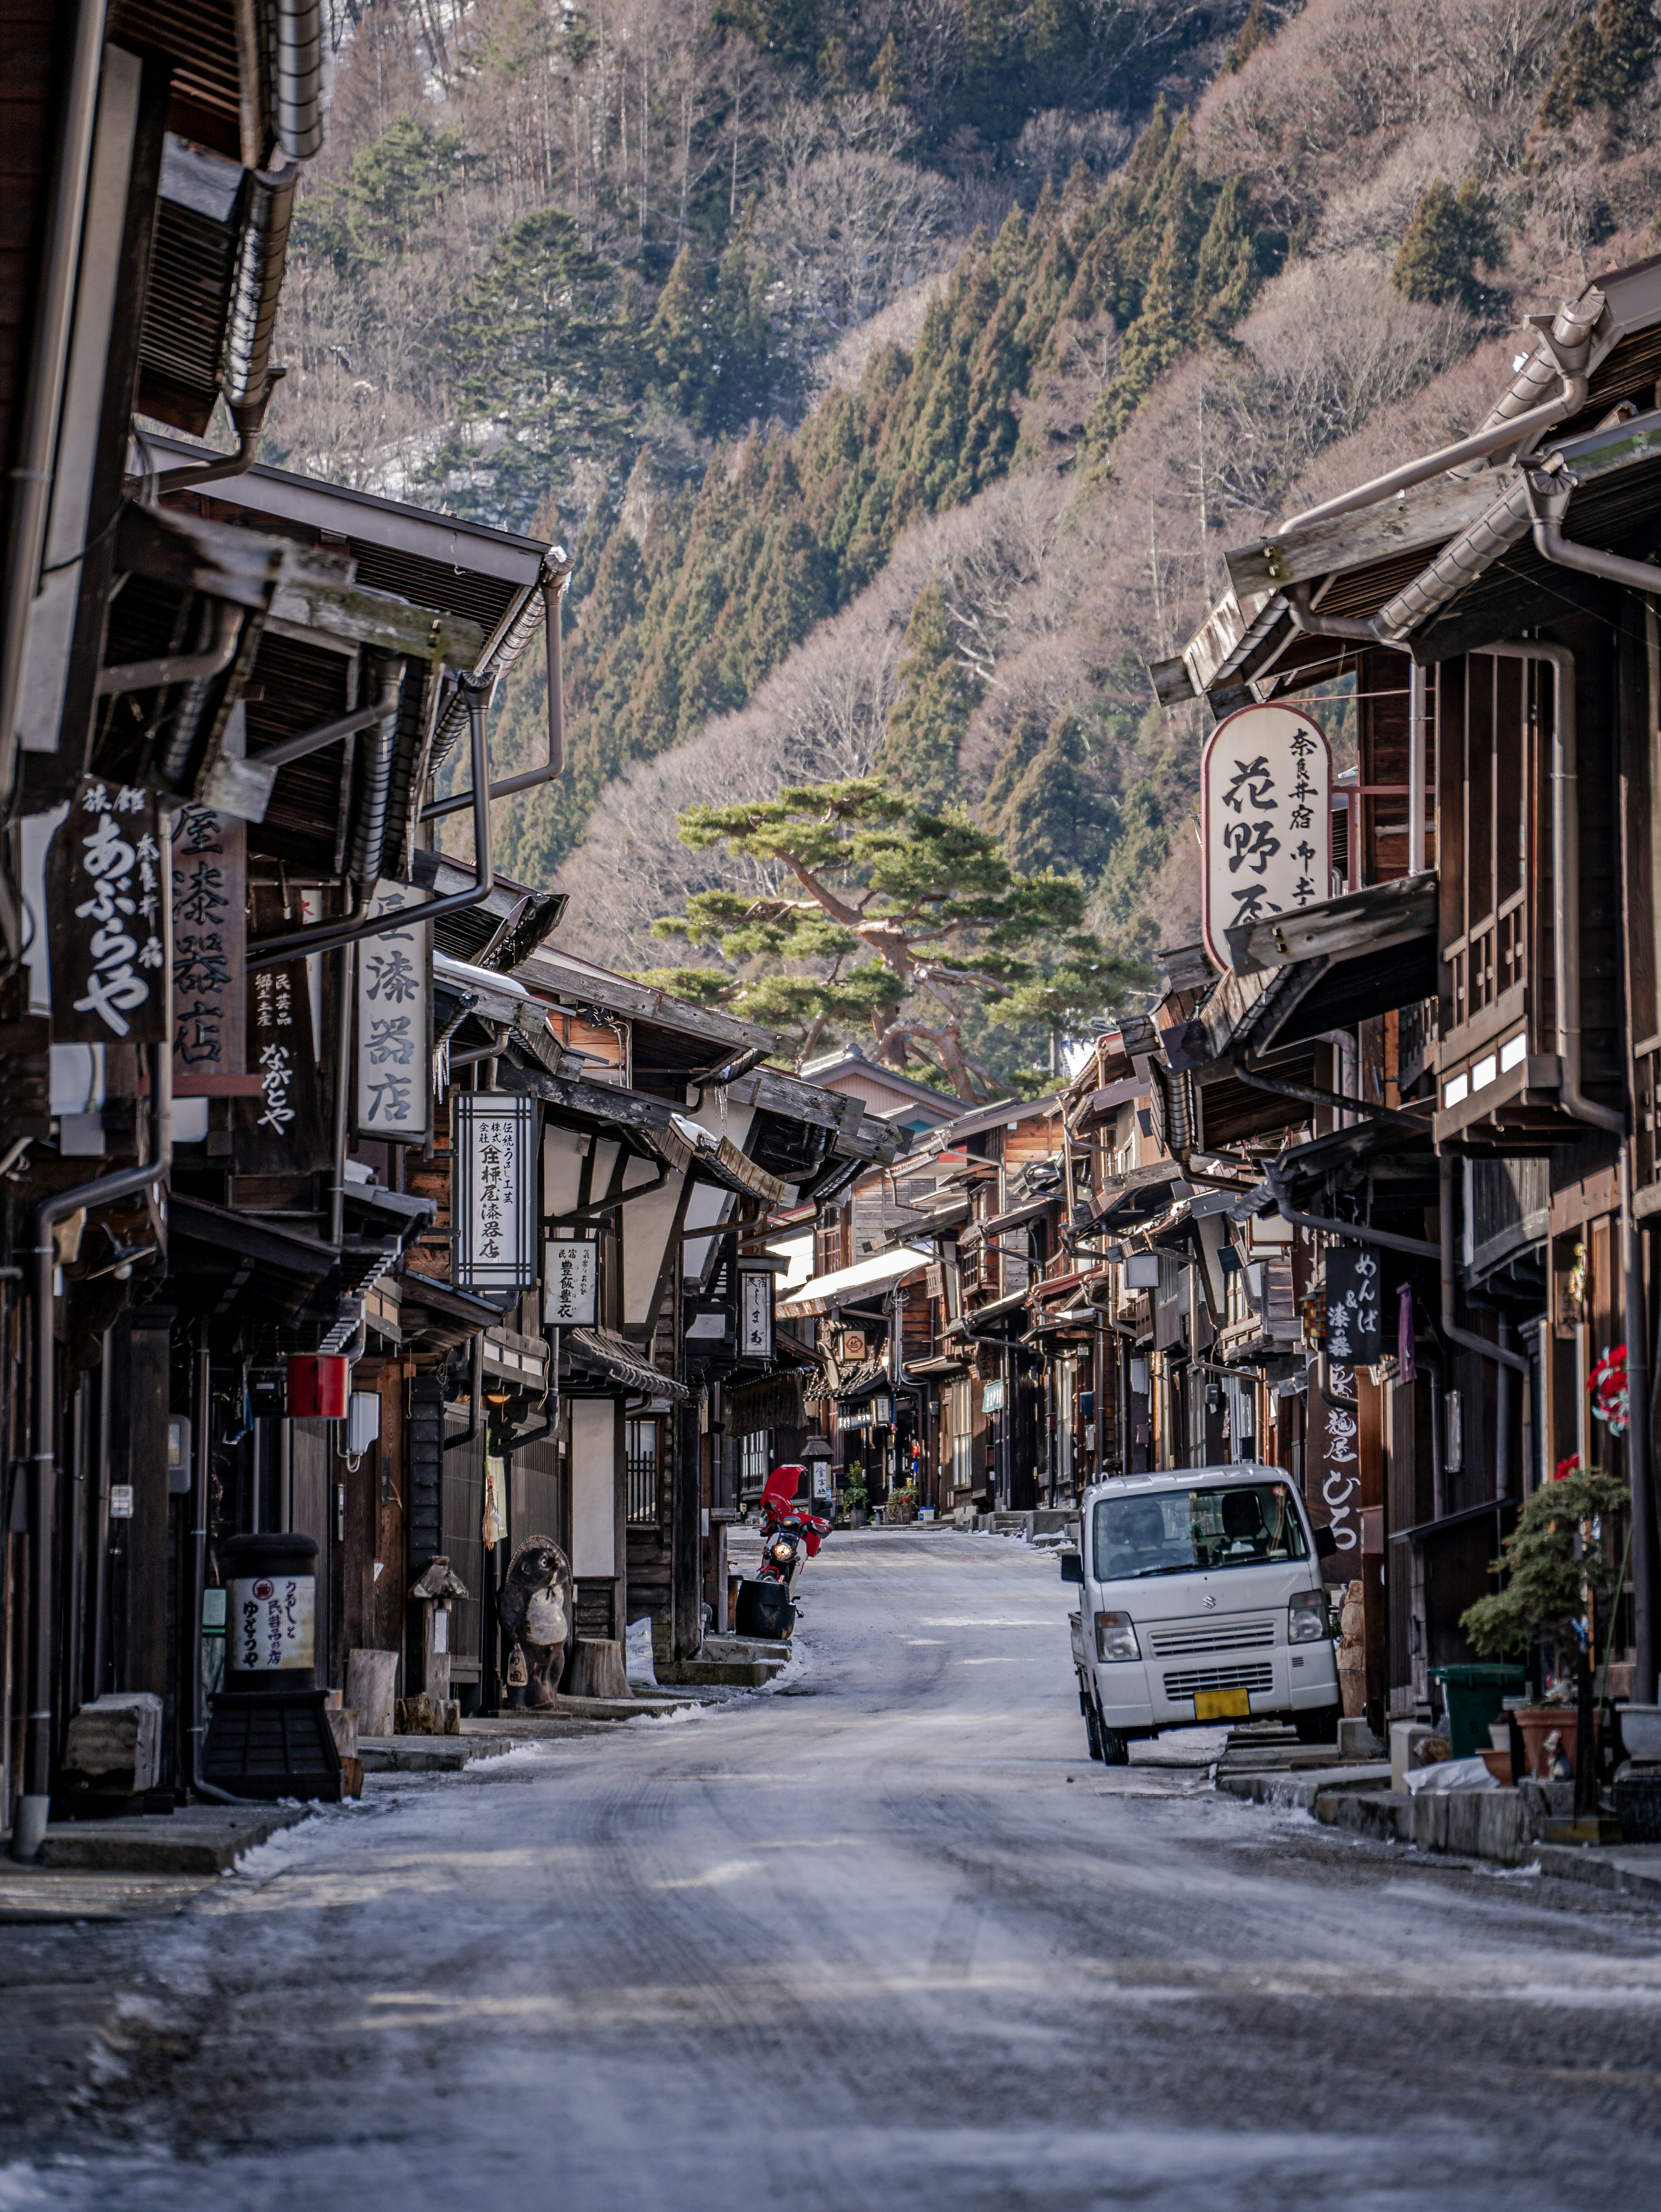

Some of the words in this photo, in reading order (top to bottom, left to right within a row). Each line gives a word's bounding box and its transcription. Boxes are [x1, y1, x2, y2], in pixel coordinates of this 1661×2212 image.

[82, 784, 146, 813] 旅館
[1288, 729, 1318, 829] 奈良井宿
[74, 815, 149, 1036] あぶらや
[136, 833, 164, 969] 奈良井宿
[275, 974, 292, 1026] 民芸品
[257, 1043, 295, 1135] ながとや
[502, 1122, 514, 1204] 伝統うるし工芸
[558, 1248, 577, 1259] 民宿
[580, 1249, 590, 1295] 気楽なおやど
[747, 1277, 766, 1288] 民宿
[1354, 1252, 1378, 1334] めんぱ
